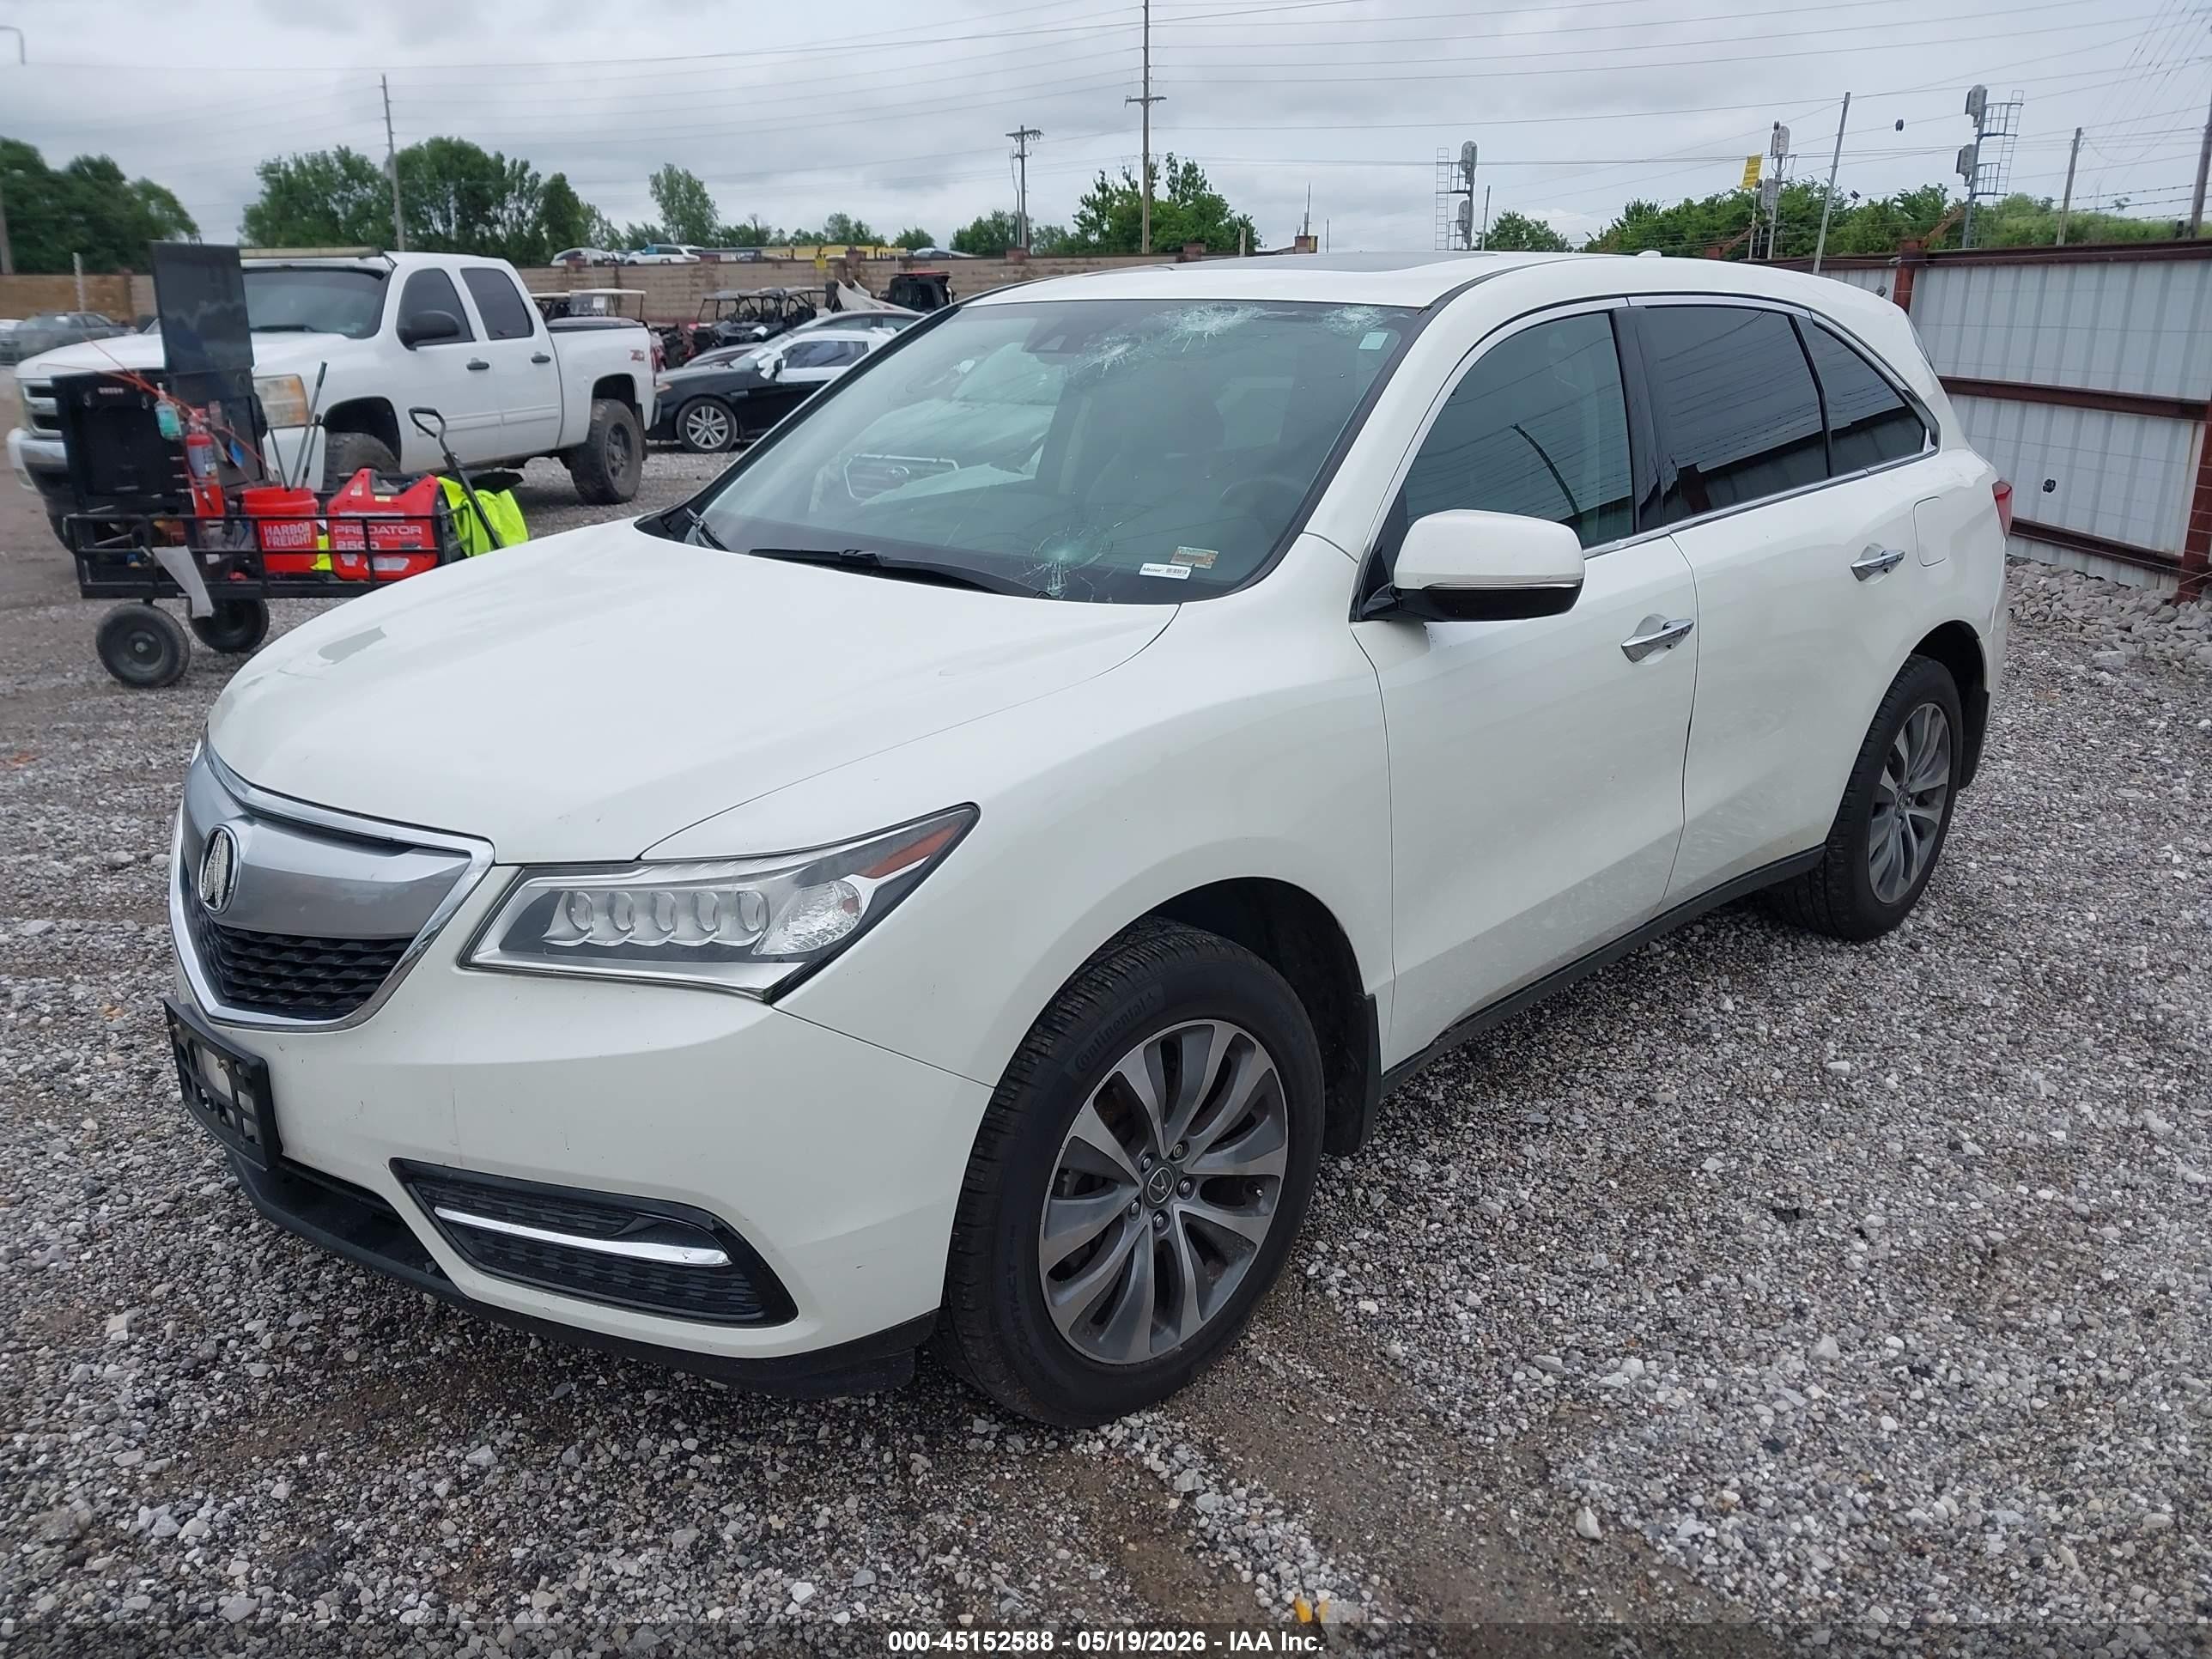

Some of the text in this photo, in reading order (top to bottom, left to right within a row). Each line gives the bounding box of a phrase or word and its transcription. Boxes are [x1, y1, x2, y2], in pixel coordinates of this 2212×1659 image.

[264, 521, 310, 537] HARBOR
[334, 525, 422, 535] PREDATOR
[265, 532, 312, 547] FREIGHT
[336, 540, 380, 550] 2500
[1074, 996, 1146, 1073] Continental
